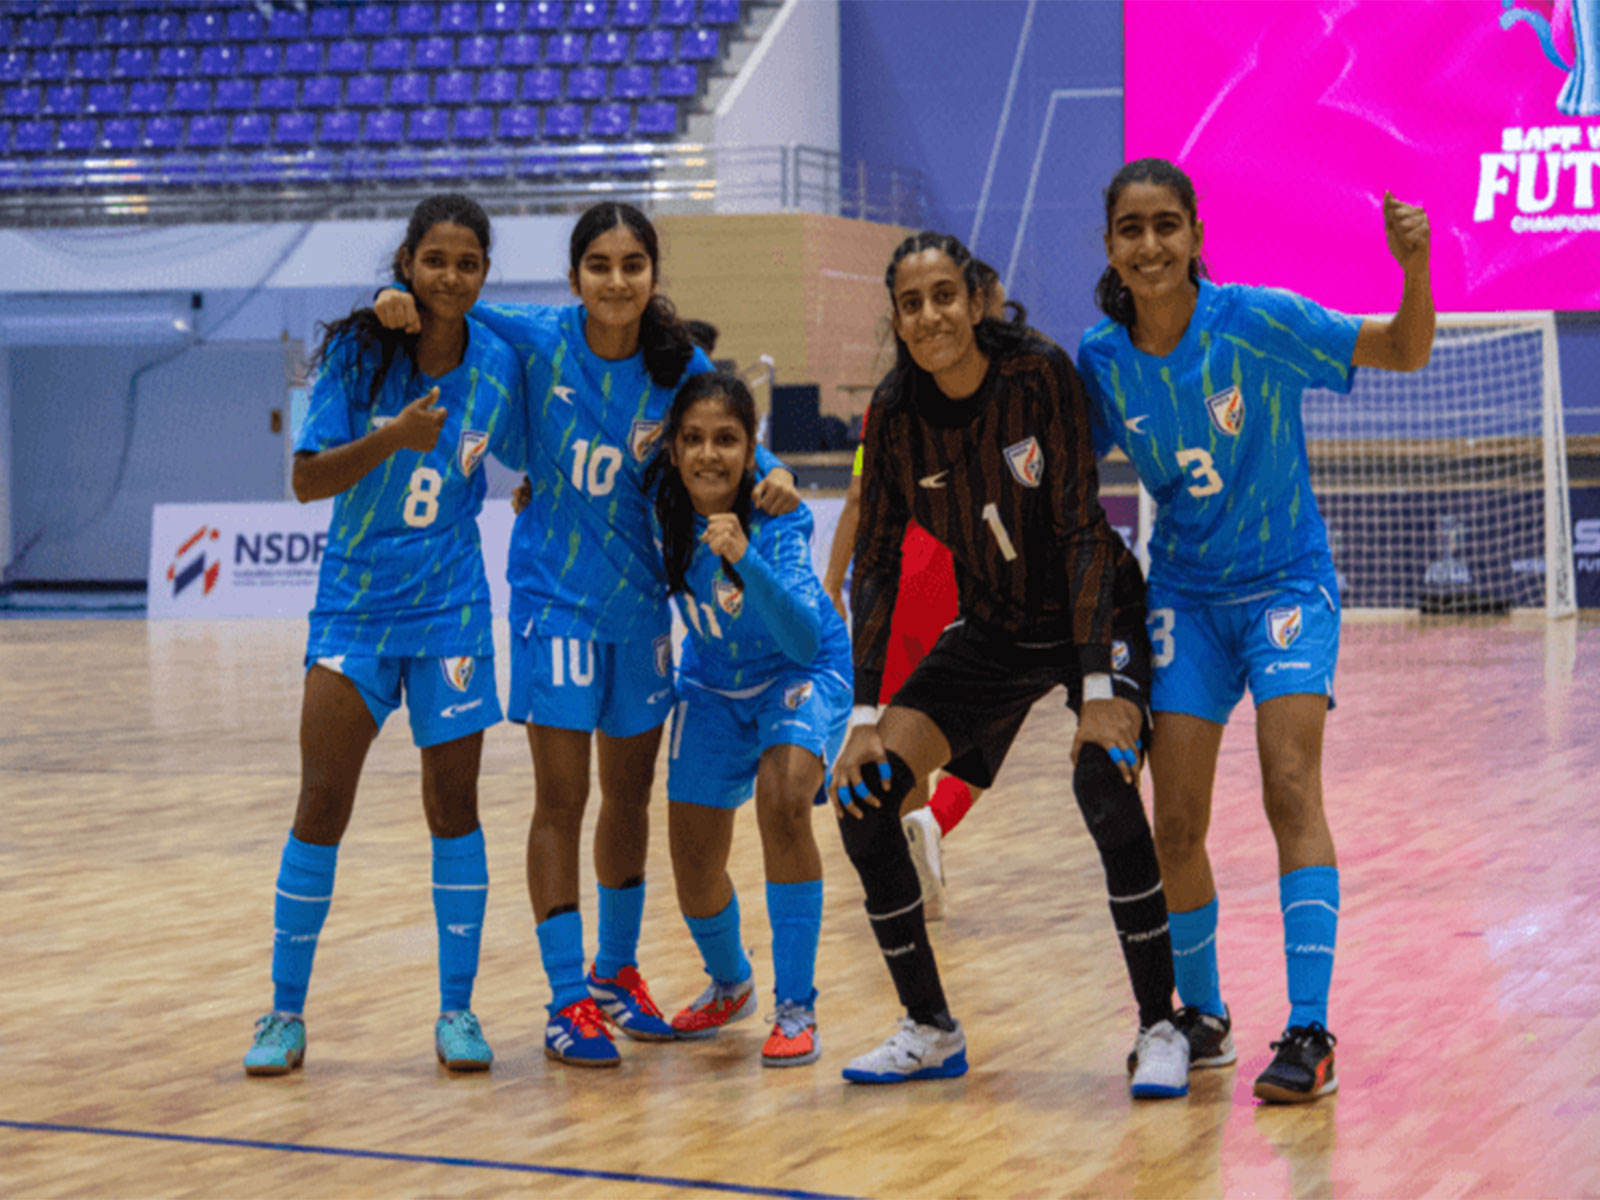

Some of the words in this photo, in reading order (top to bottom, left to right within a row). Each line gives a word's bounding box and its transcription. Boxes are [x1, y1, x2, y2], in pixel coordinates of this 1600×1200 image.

[571, 438, 623, 496] 10
[1175, 447, 1224, 498] 3
[403, 466, 442, 528] 8
[982, 502, 1018, 562] 1
[683, 592, 723, 639] 11
[1146, 608, 1175, 668] 3
[552, 637, 594, 686] 10
